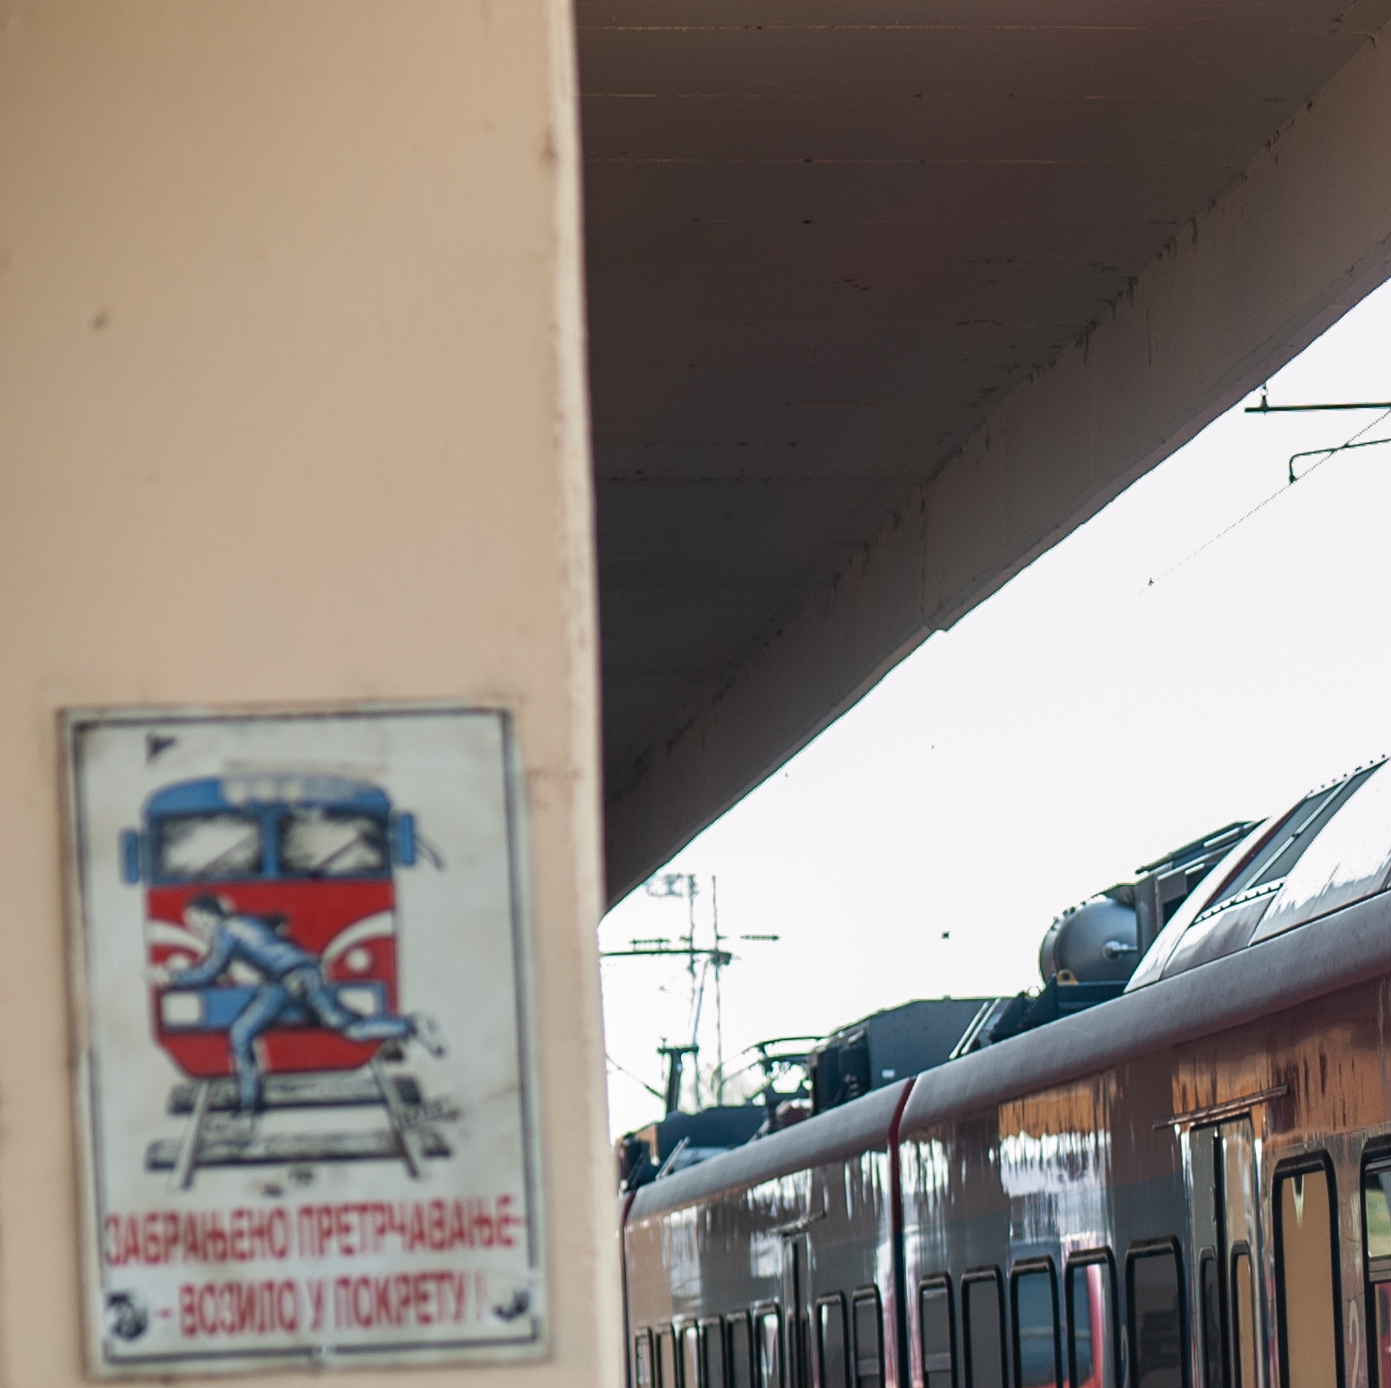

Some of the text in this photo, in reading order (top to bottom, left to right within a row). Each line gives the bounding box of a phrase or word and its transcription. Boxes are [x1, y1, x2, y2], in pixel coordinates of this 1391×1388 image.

[103, 1207, 288, 1266] ЗАБРАЊЕНО
[179, 1279, 297, 1337] ВОЗИЛО
[306, 1277, 328, 1331] У
